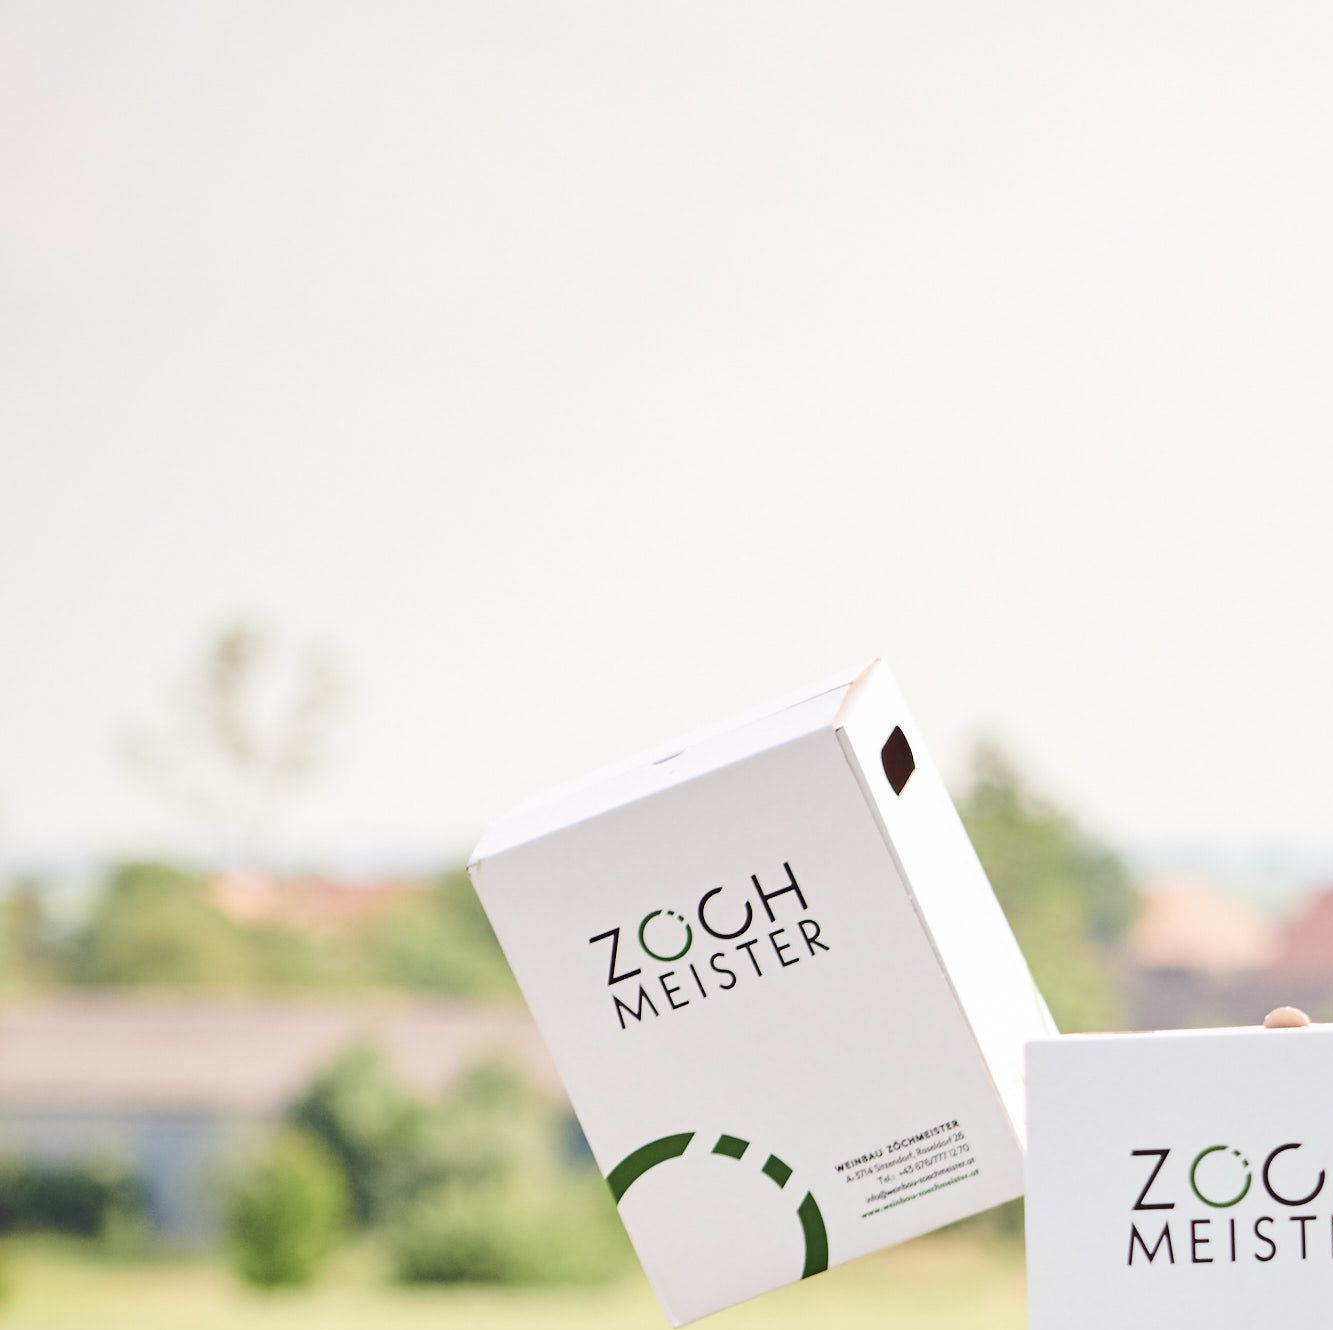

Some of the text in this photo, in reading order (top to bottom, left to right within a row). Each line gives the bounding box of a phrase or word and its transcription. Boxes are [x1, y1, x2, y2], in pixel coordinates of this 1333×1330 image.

[613, 918, 829, 1030] MEISTER
[834, 1119, 960, 1173] WEINBAU ZÖCHMEISTER
